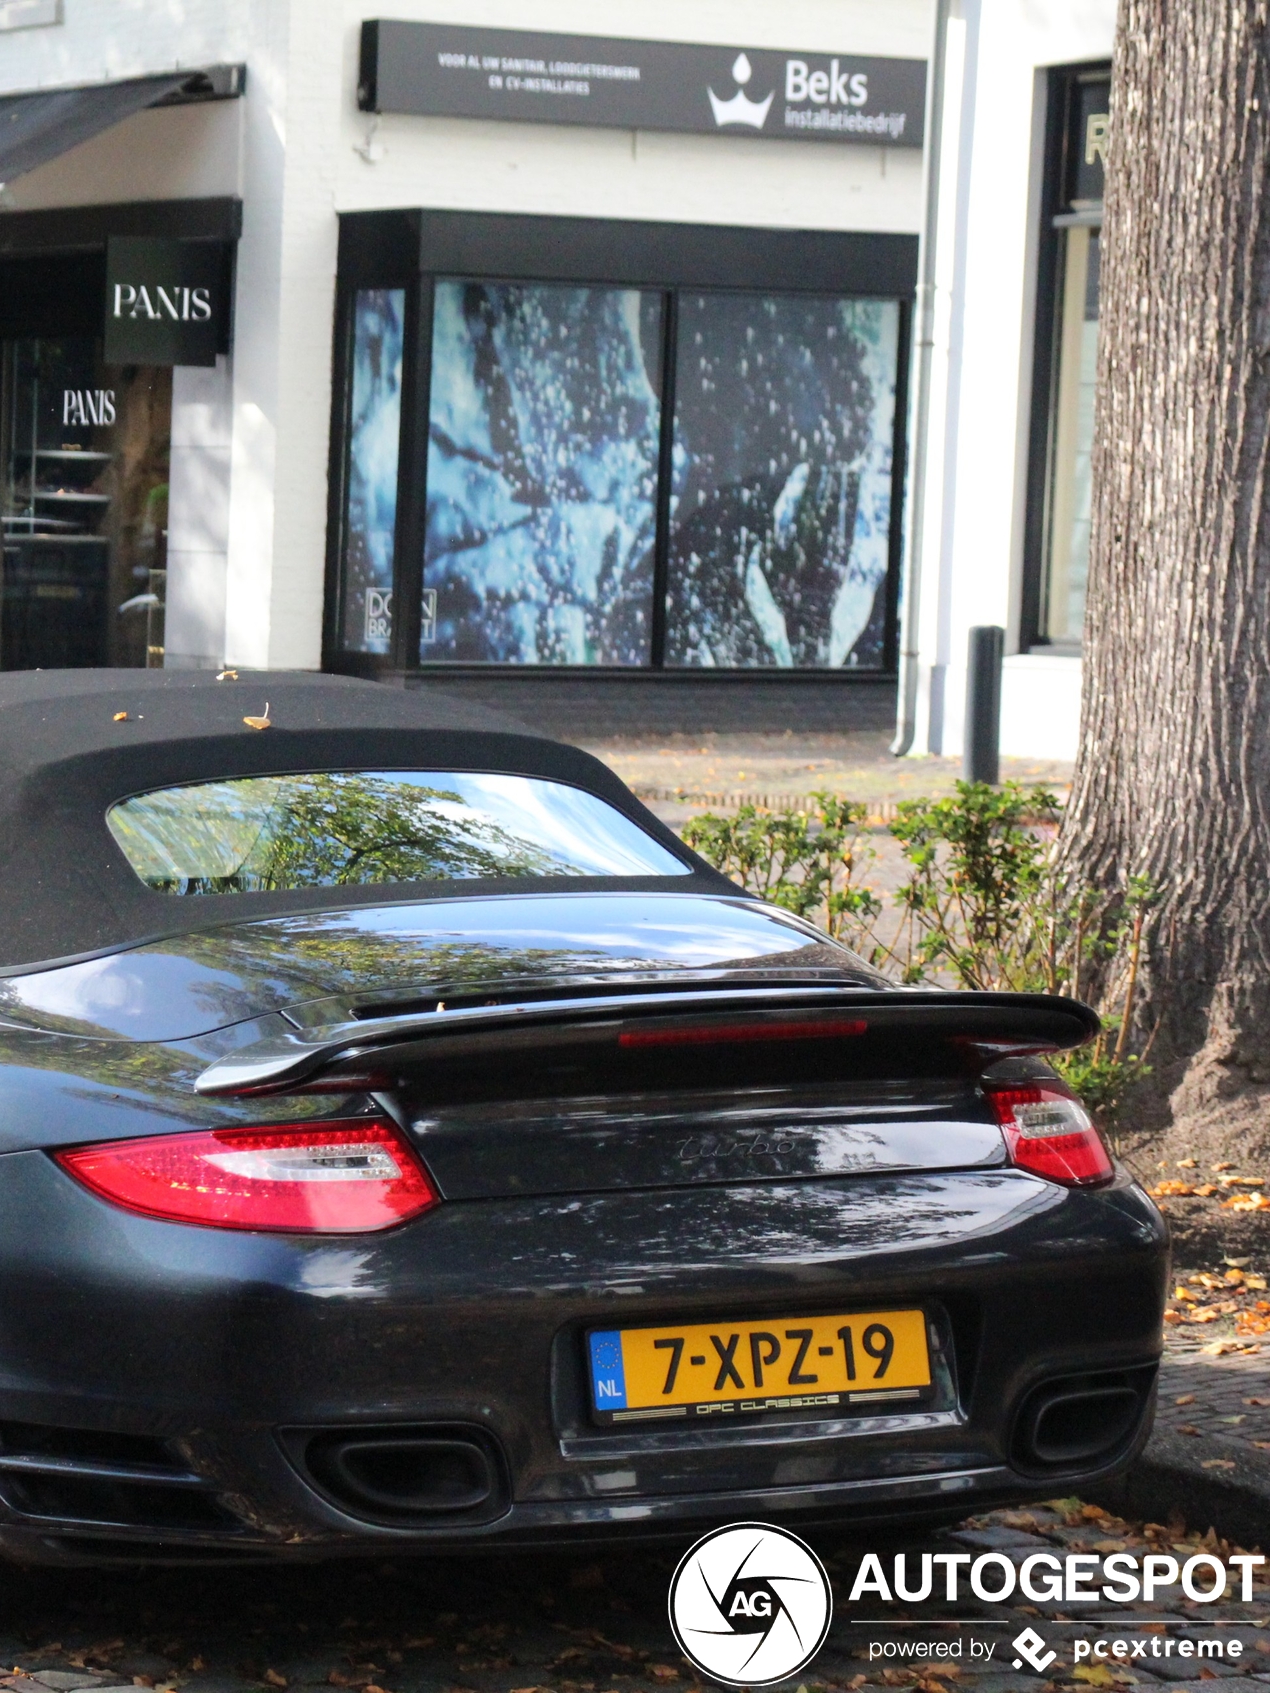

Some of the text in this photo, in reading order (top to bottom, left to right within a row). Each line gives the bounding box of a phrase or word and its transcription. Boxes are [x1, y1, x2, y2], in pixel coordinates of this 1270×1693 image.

[438, 52, 467, 68] VOOR
[467, 55, 480, 69] AL
[482, 56, 500, 71] UW
[488, 74, 591, 96] EN CV-INSTALLATIES
[785, 58, 868, 106] Beks
[784, 106, 907, 139] installatiebedrijf
[113, 283, 211, 322] PANIS
[62, 389, 117, 427] PANIS
[676, 1134, 795, 1160] turbo
[653, 1323, 895, 1395] 7-XPZ-19
[598, 1379, 623, 1398] NL
[740, 1394, 840, 1411] CLASSICS
